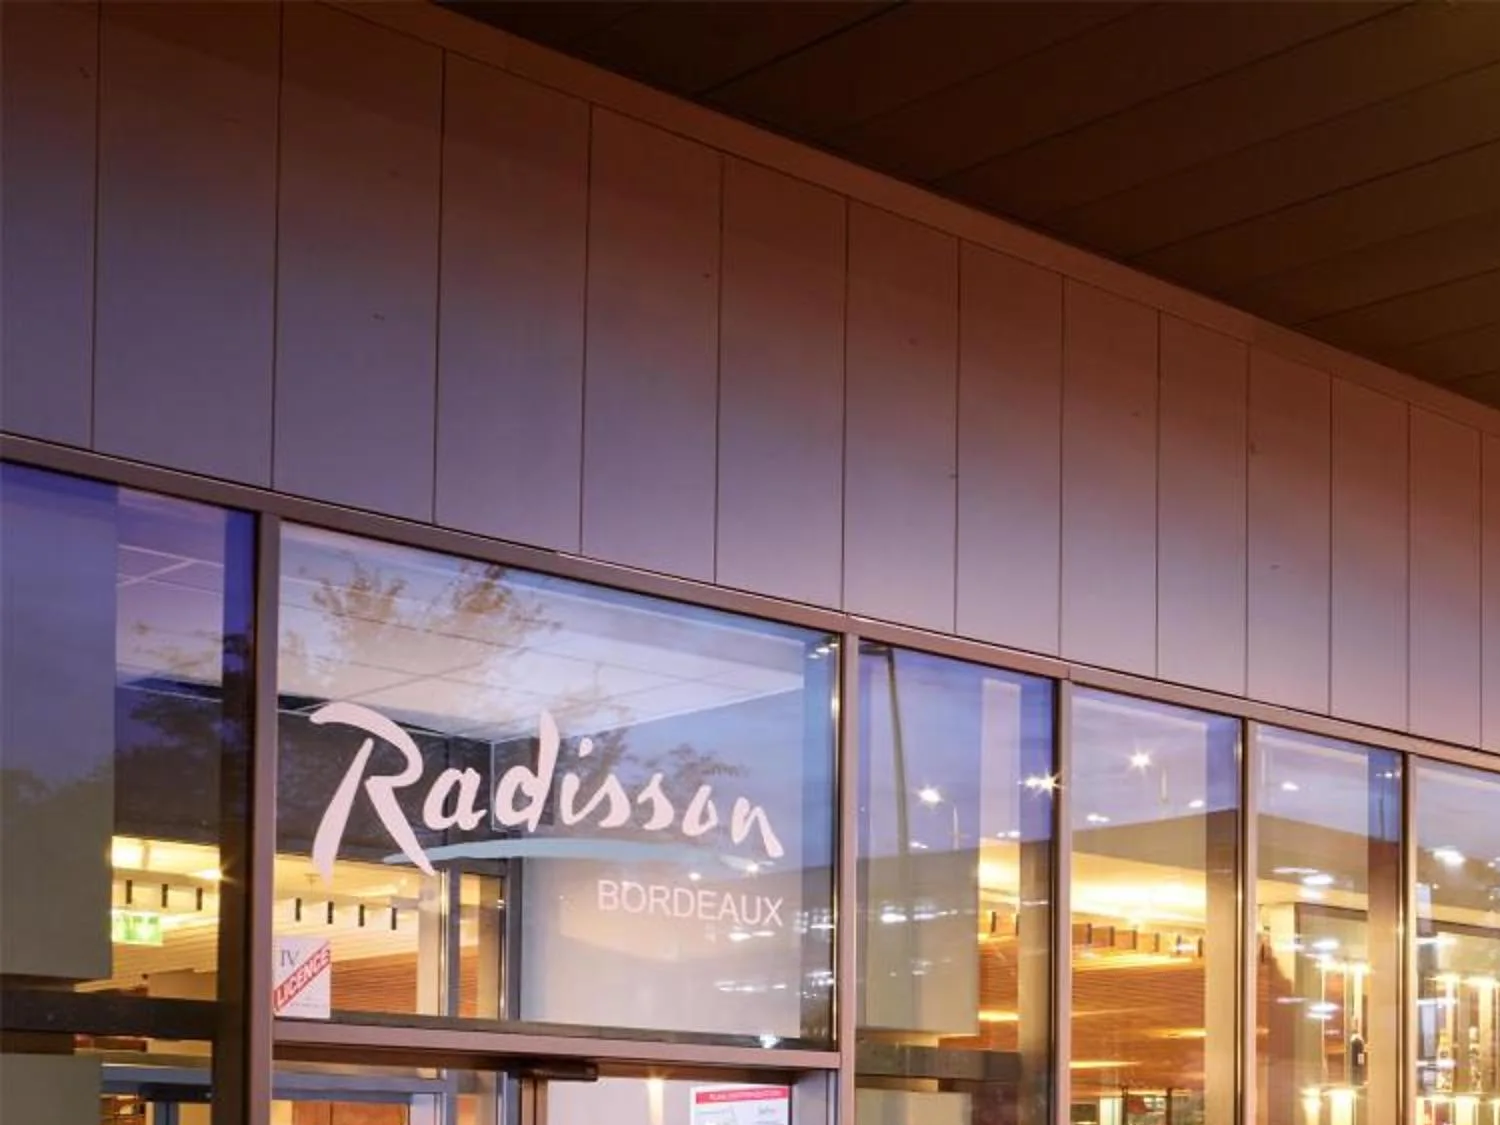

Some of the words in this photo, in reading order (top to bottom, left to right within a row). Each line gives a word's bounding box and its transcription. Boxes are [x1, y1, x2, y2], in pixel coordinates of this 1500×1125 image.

[309, 701, 785, 888] Radisson
[598, 879, 784, 928] BORDEAUX
[276, 948, 331, 1009] LICENCE
[281, 949, 300, 967] IV
